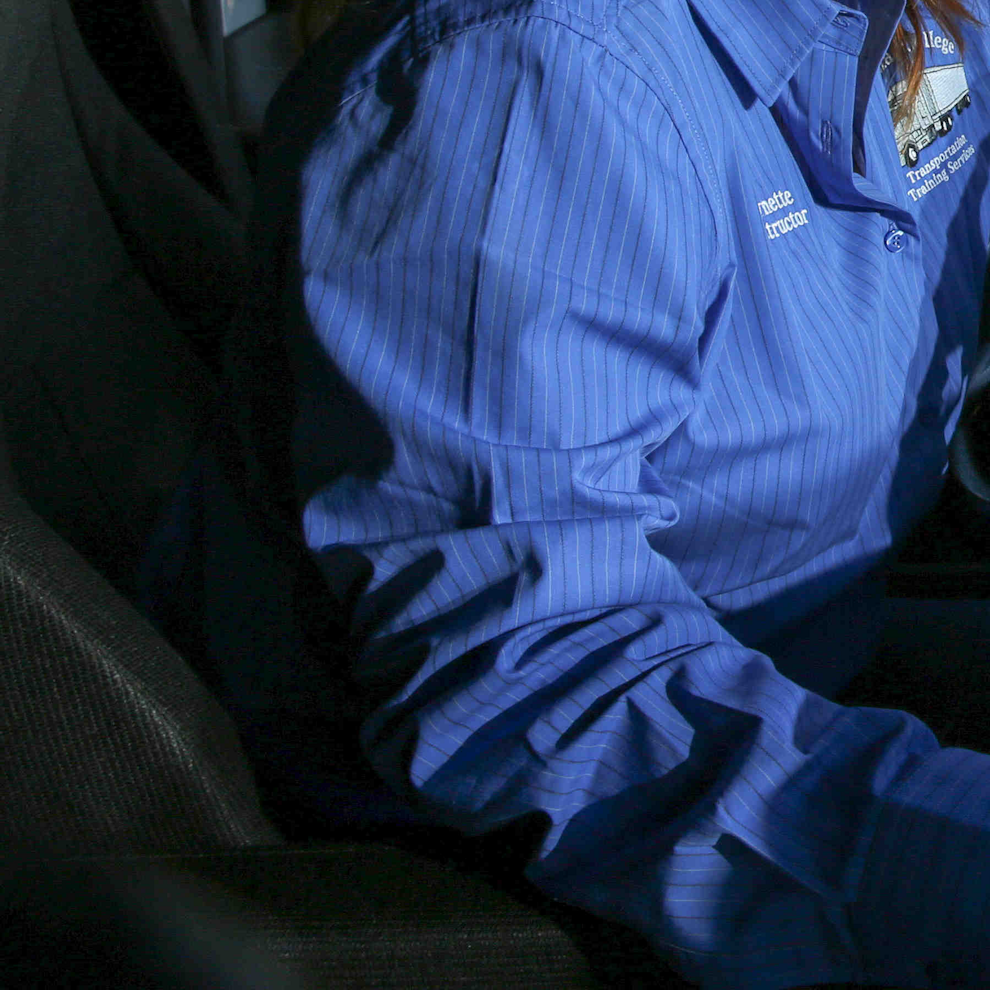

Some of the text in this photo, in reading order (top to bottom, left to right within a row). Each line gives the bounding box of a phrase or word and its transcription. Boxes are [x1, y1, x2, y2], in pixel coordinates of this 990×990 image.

[922, 30, 955, 55] llege
[906, 134, 968, 184] Transportation
[907, 144, 976, 202] Training Services
[757, 190, 795, 216] nette
[765, 208, 809, 240] tructor
